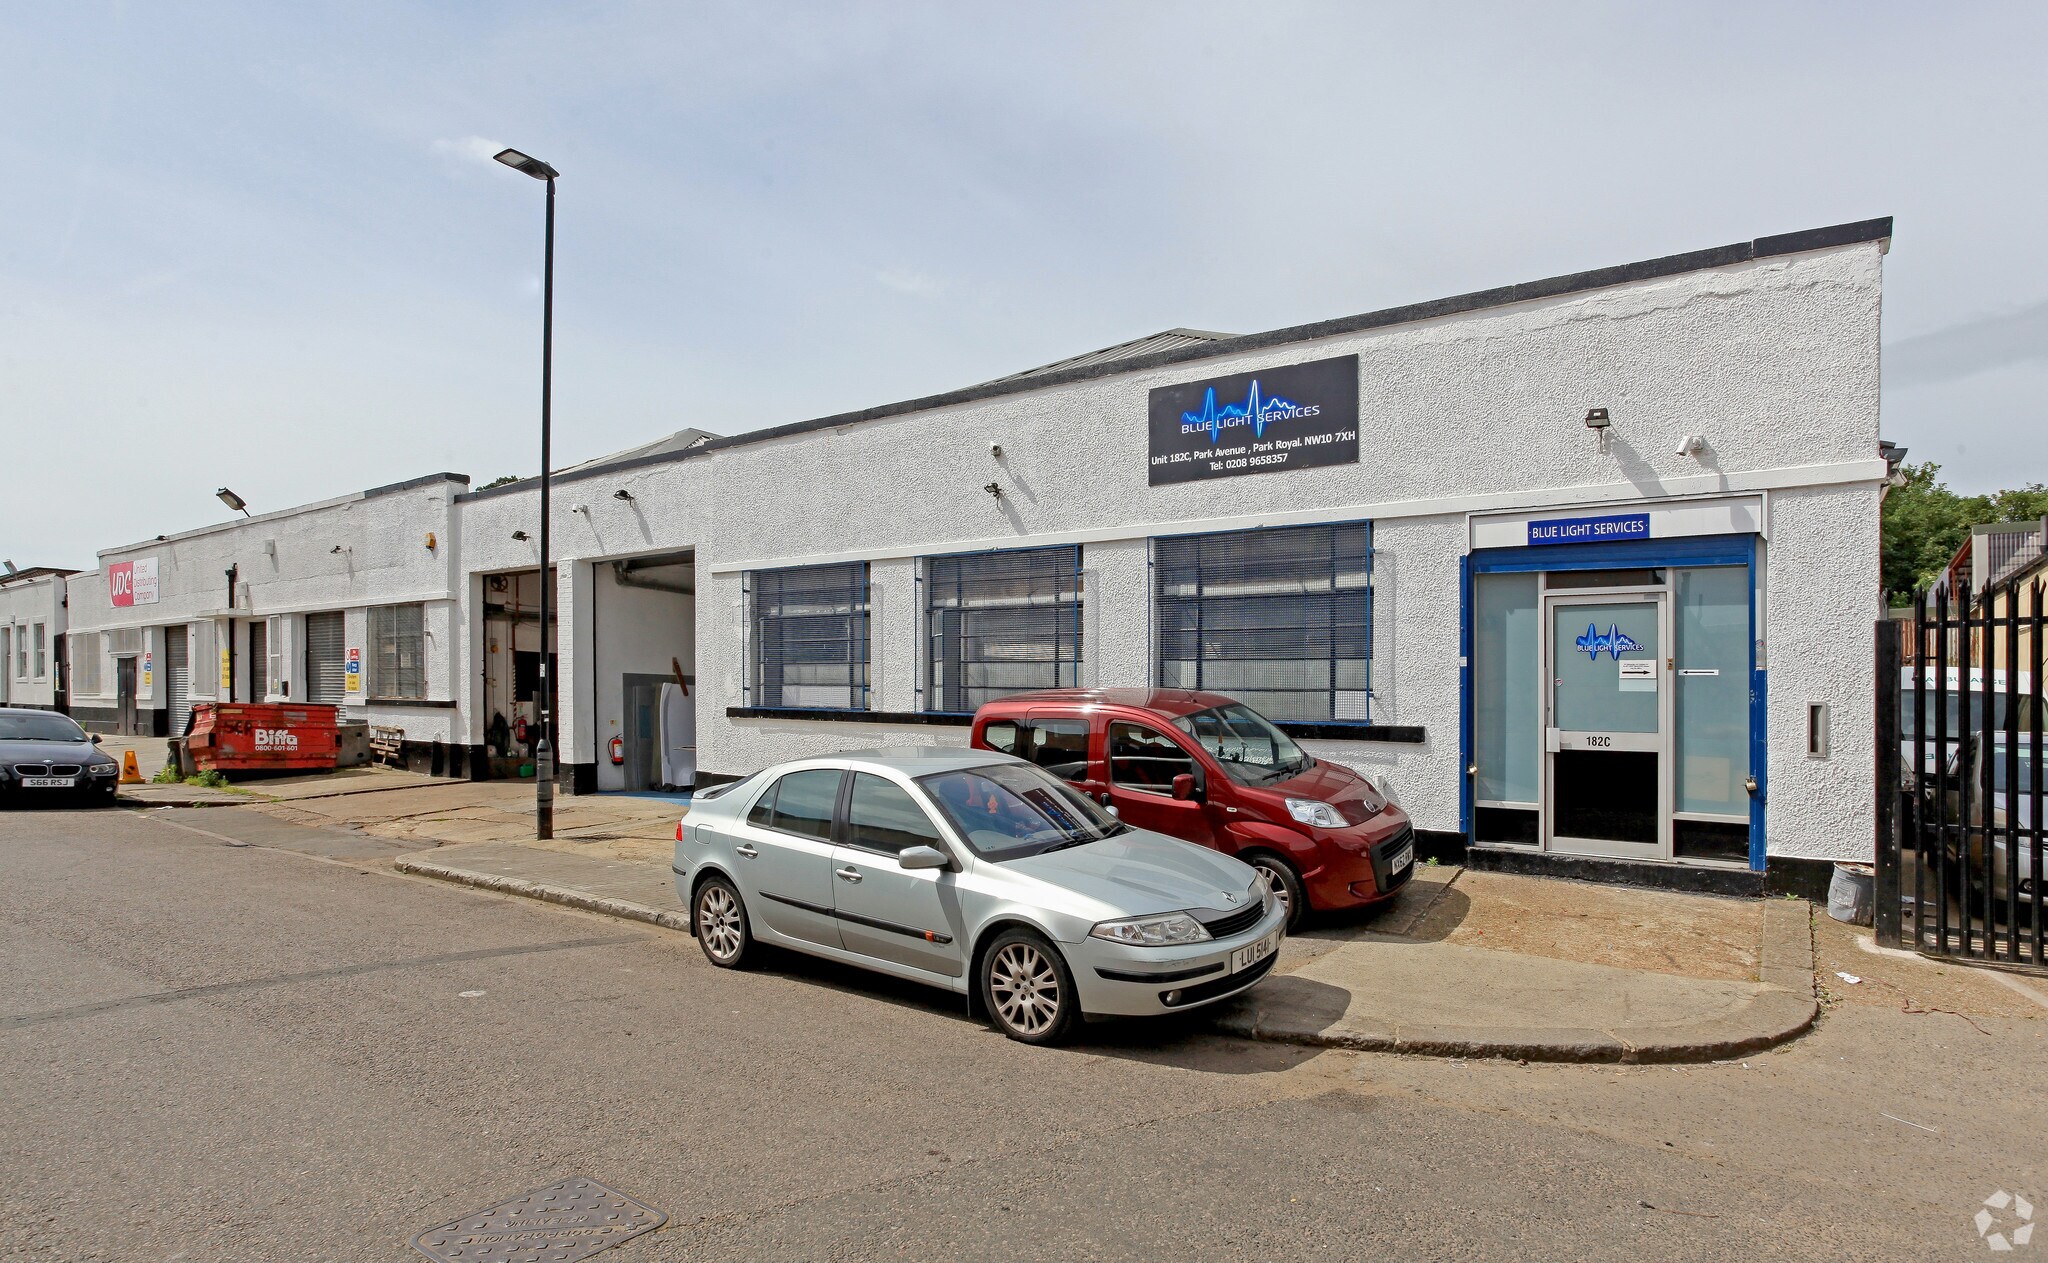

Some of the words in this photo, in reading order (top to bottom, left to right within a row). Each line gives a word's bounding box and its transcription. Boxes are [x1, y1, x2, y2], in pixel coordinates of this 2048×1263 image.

[1181, 420, 1213, 434] BLUE
[1216, 414, 1254, 429] LIGHT
[1257, 405, 1320, 423] SERVICES
[1151, 454, 1168, 465] Unit
[1169, 452, 1192, 463] 182C,
[1194, 448, 1213, 460] Park
[1215, 445, 1246, 457] Avenue
[1252, 441, 1274, 453] Park
[1275, 437, 1303, 450] Royal.
[1304, 433, 1332, 446] NW10
[1334, 430, 1356, 442] 7XH
[1209, 461, 1224, 471] Tel:
[1225, 457, 1248, 469] 0208
[1249, 452, 1289, 466] 9658357
[1532, 525, 1558, 538] BLUE
[1560, 523, 1592, 537] LIGHT
[1593, 520, 1645, 535] SERVICES
[112, 570, 131, 596] UDC
[1577, 644, 1593, 652] BLUE
[1595, 644, 1613, 652] LIGHT
[1614, 643, 1644, 651] SERVICES
[255, 729, 298, 745] Biffa
[1586, 736, 1611, 748] 182C
